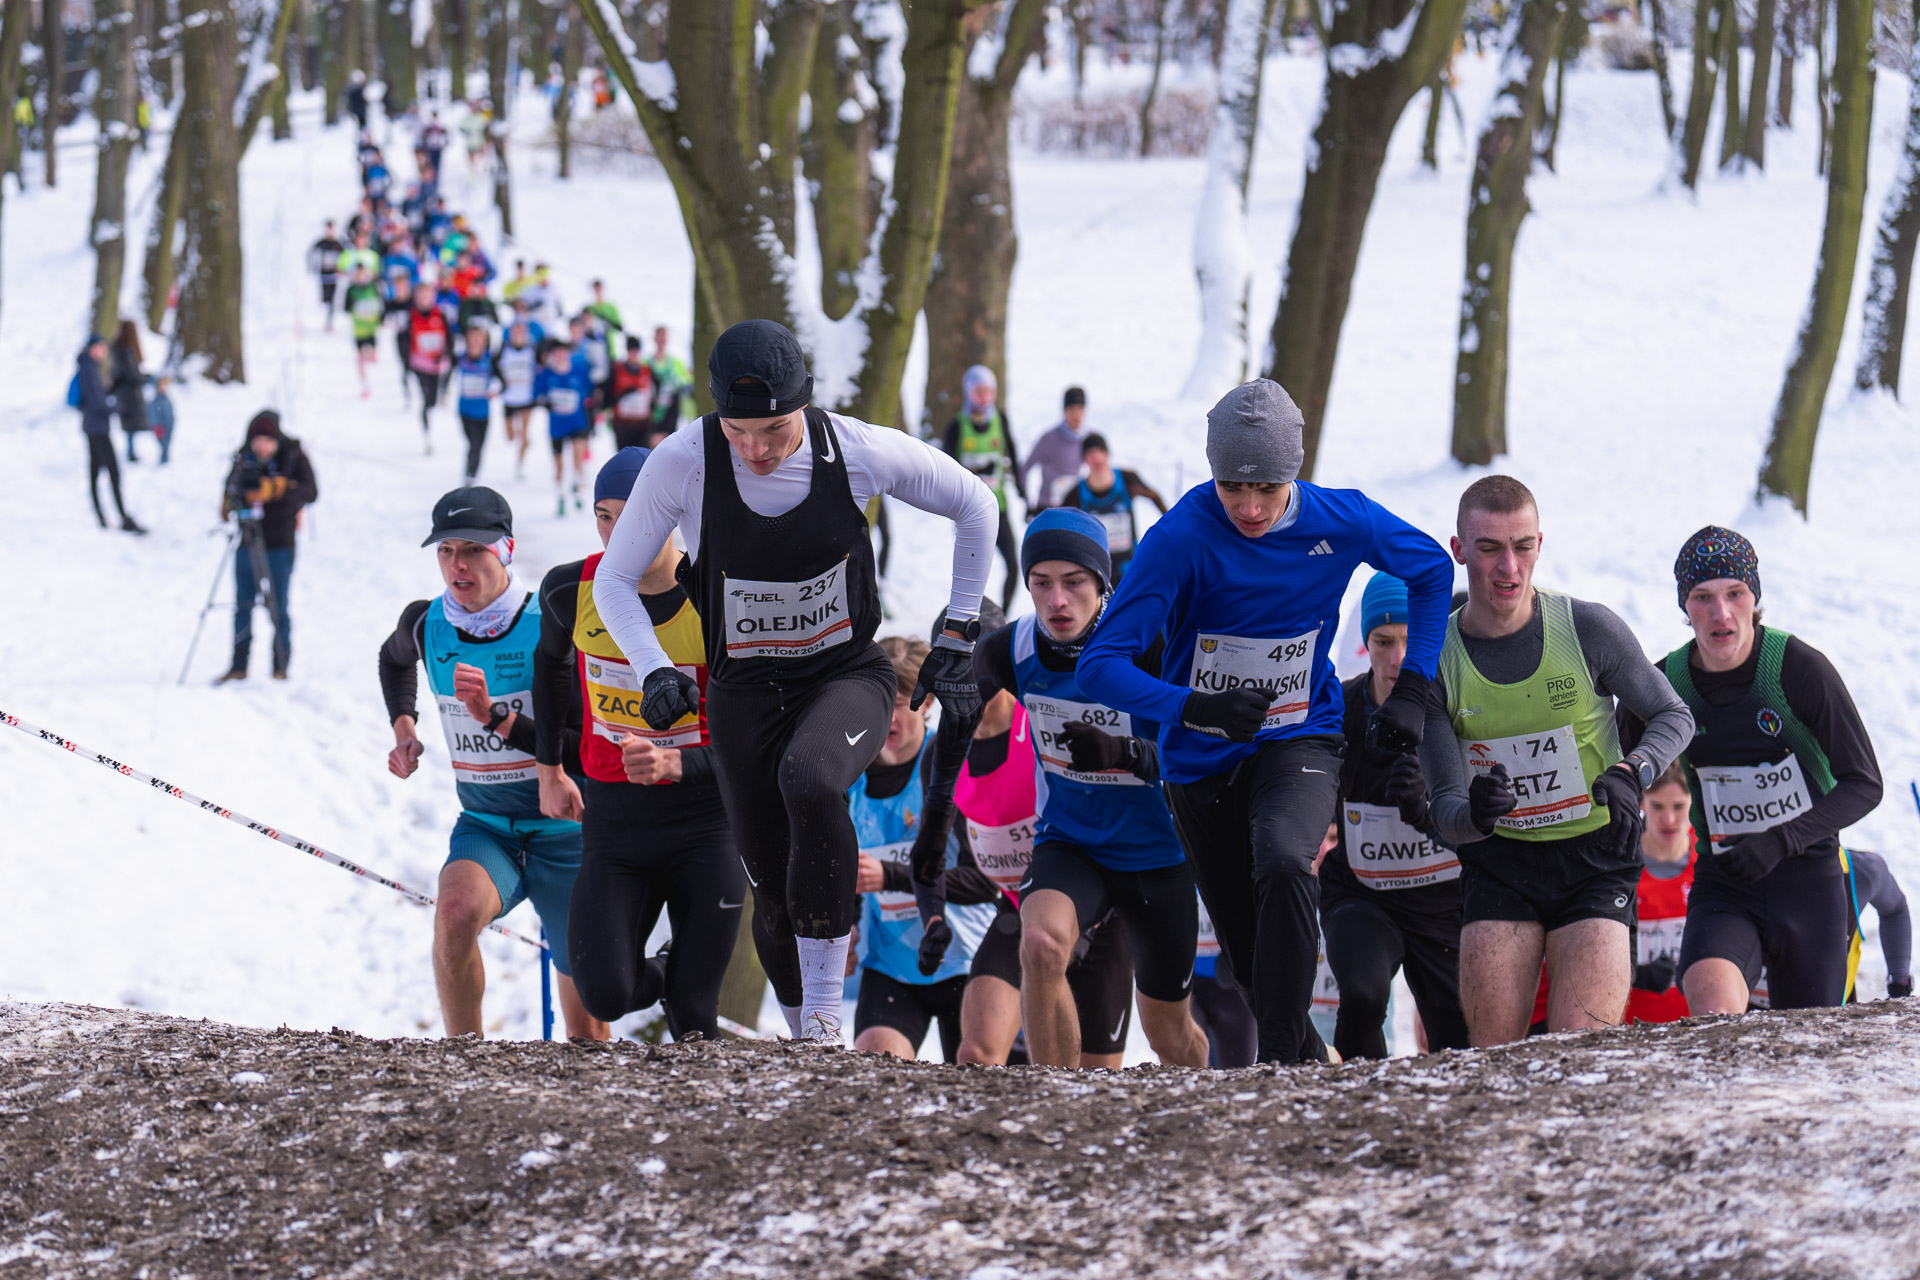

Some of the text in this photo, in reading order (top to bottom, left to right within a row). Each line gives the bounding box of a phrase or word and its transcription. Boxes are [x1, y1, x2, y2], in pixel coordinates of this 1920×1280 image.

[1238, 465, 1258, 474] 4F
[798, 569, 838, 602] 237
[744, 593, 785, 603] FUEL
[735, 595, 840, 634] OLEJNIK
[758, 640, 826, 656] BYTOM 2024
[1267, 639, 1308, 663] 498
[1547, 677, 1576, 694] PRO
[1549, 689, 1578, 703] athlete
[1038, 702, 1056, 714] 770
[1081, 709, 1121, 727] 682
[1261, 717, 1281, 727] 024
[455, 732, 515, 754] JARO
[1526, 736, 1558, 758] 74
[1469, 759, 1497, 767] ORLEN
[471, 771, 526, 782] BYTOM 2024
[1062, 769, 1119, 783] BYTOM 2024
[1508, 769, 1562, 797] ETZ
[1754, 766, 1793, 790] 390
[1712, 791, 1803, 824] KOSICKI
[1499, 812, 1564, 828] BYTOM 2024
[1008, 820, 1037, 842] 51
[1375, 874, 1437, 889] BYTOM 2024
